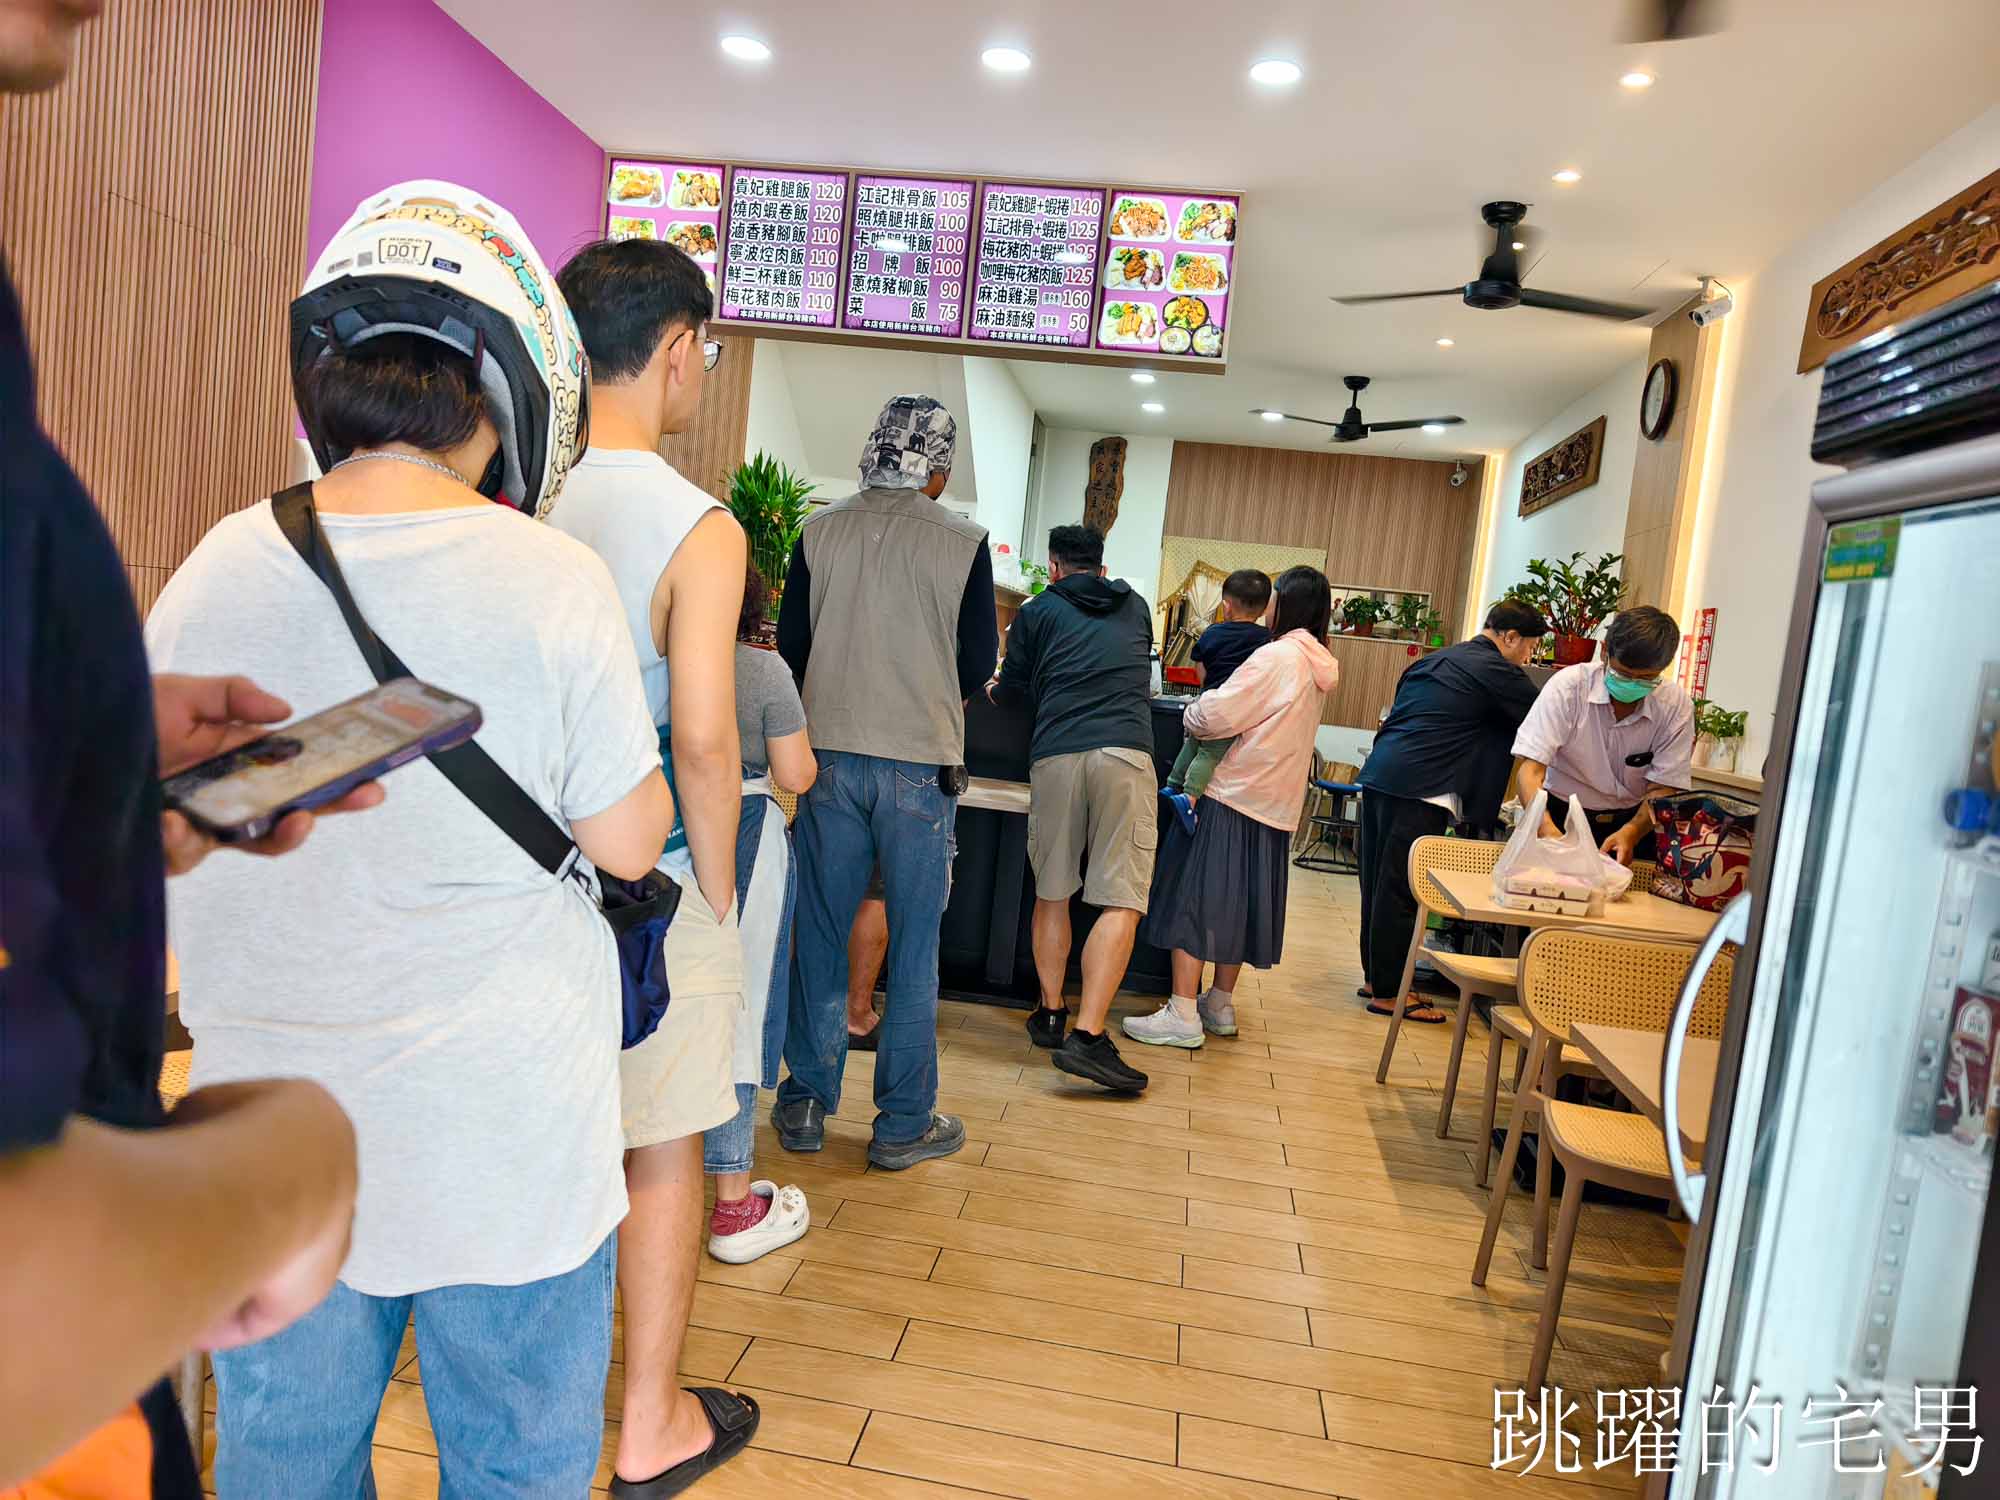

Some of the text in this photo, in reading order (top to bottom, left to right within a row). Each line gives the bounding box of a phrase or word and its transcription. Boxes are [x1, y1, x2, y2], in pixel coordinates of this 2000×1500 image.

[735, 178, 843, 200] 貴妃雞腿飯 120
[859, 186, 968, 208] 江記排骨飯 105
[732, 200, 841, 222] 燒肉蝦卷飯 120
[1073, 199, 1100, 216] 140
[857, 208, 966, 230] 照燒腿排飯 100
[985, 217, 1097, 239] 江記排骨+蝦捲 125
[731, 221, 839, 244] 滷香豬腳飯 110
[386, 244, 421, 258] DOT
[937, 237, 963, 253] 100
[811, 251, 837, 266] 110
[935, 260, 961, 275] 100
[728, 265, 835, 288] 鮮三杯雞飯 110
[980, 262, 1092, 285] 咖哩梅花豬肉飯 125
[726, 287, 833, 310] 梅花豬肉飯 110
[941, 282, 960, 298] 90
[977, 285, 1038, 306] 麻油雞湯
[1064, 290, 1090, 307] 160
[940, 305, 957, 320] 75
[1070, 314, 1088, 330] 50
